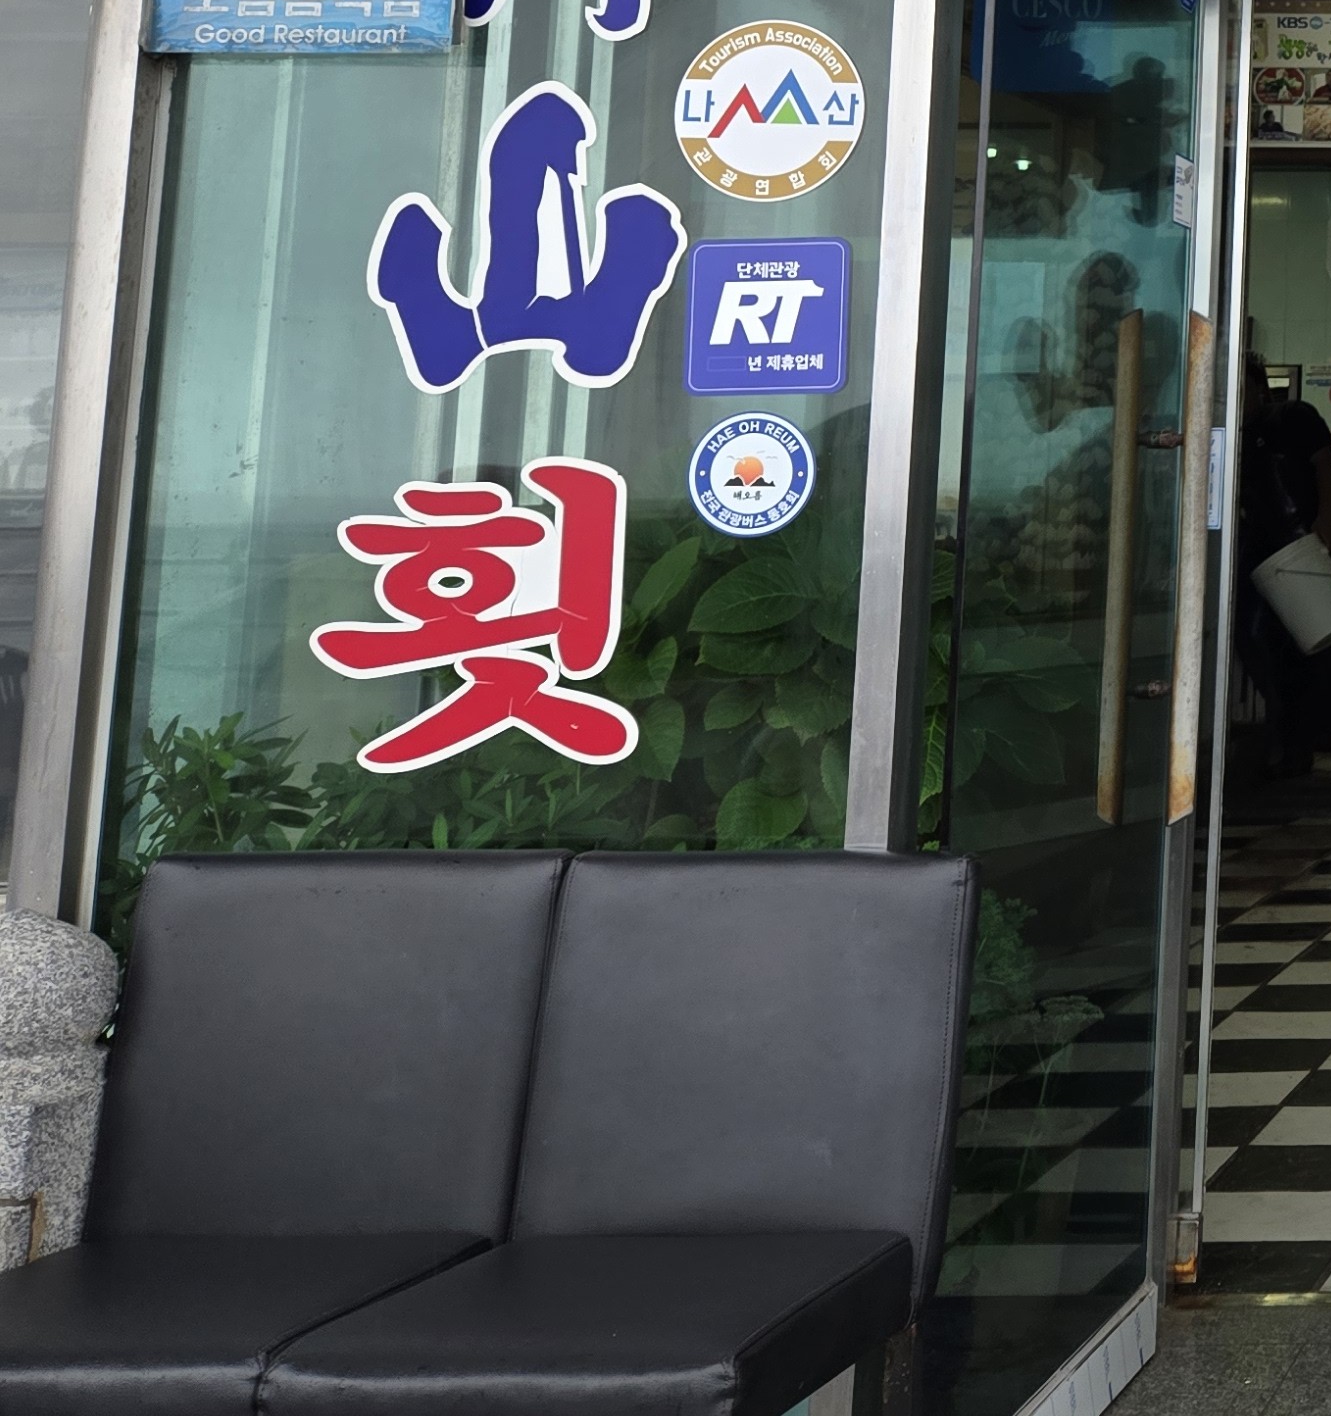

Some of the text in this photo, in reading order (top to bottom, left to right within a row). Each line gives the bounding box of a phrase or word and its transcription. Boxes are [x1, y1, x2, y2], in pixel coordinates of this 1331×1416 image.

[194, 24, 407, 45] Good Restaurant
[1276, 17, 1309, 29] KBS
[699, 27, 843, 76] Tourism Association
[822, 90, 860, 126] 산
[736, 261, 800, 279] 단체관광
[709, 279, 825, 345] RT
[747, 353, 825, 372] 년 제휴업체
[707, 420, 800, 454] HAE OH REUM
[700, 489, 721, 514] 전국
[767, 489, 800, 522] 동호회
